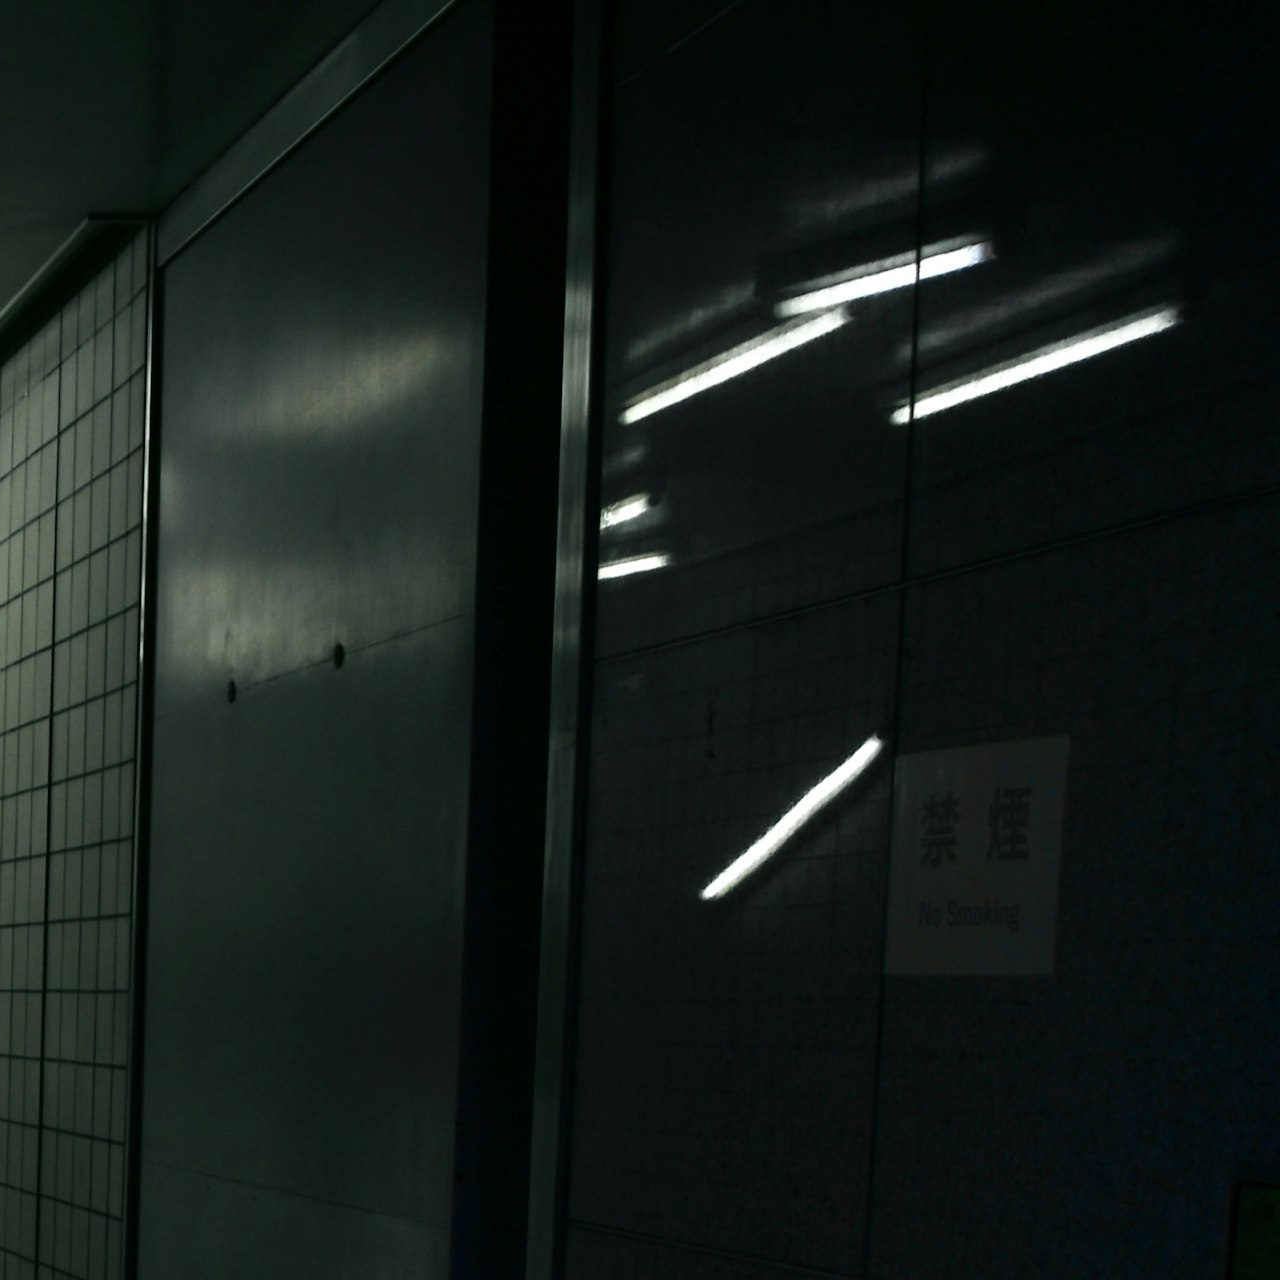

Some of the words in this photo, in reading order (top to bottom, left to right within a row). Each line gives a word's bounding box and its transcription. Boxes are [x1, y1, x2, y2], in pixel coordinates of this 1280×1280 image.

[919, 785, 1033, 868] 禁煙
[918, 900, 943, 928] No
[946, 898, 1021, 932] Smoking
